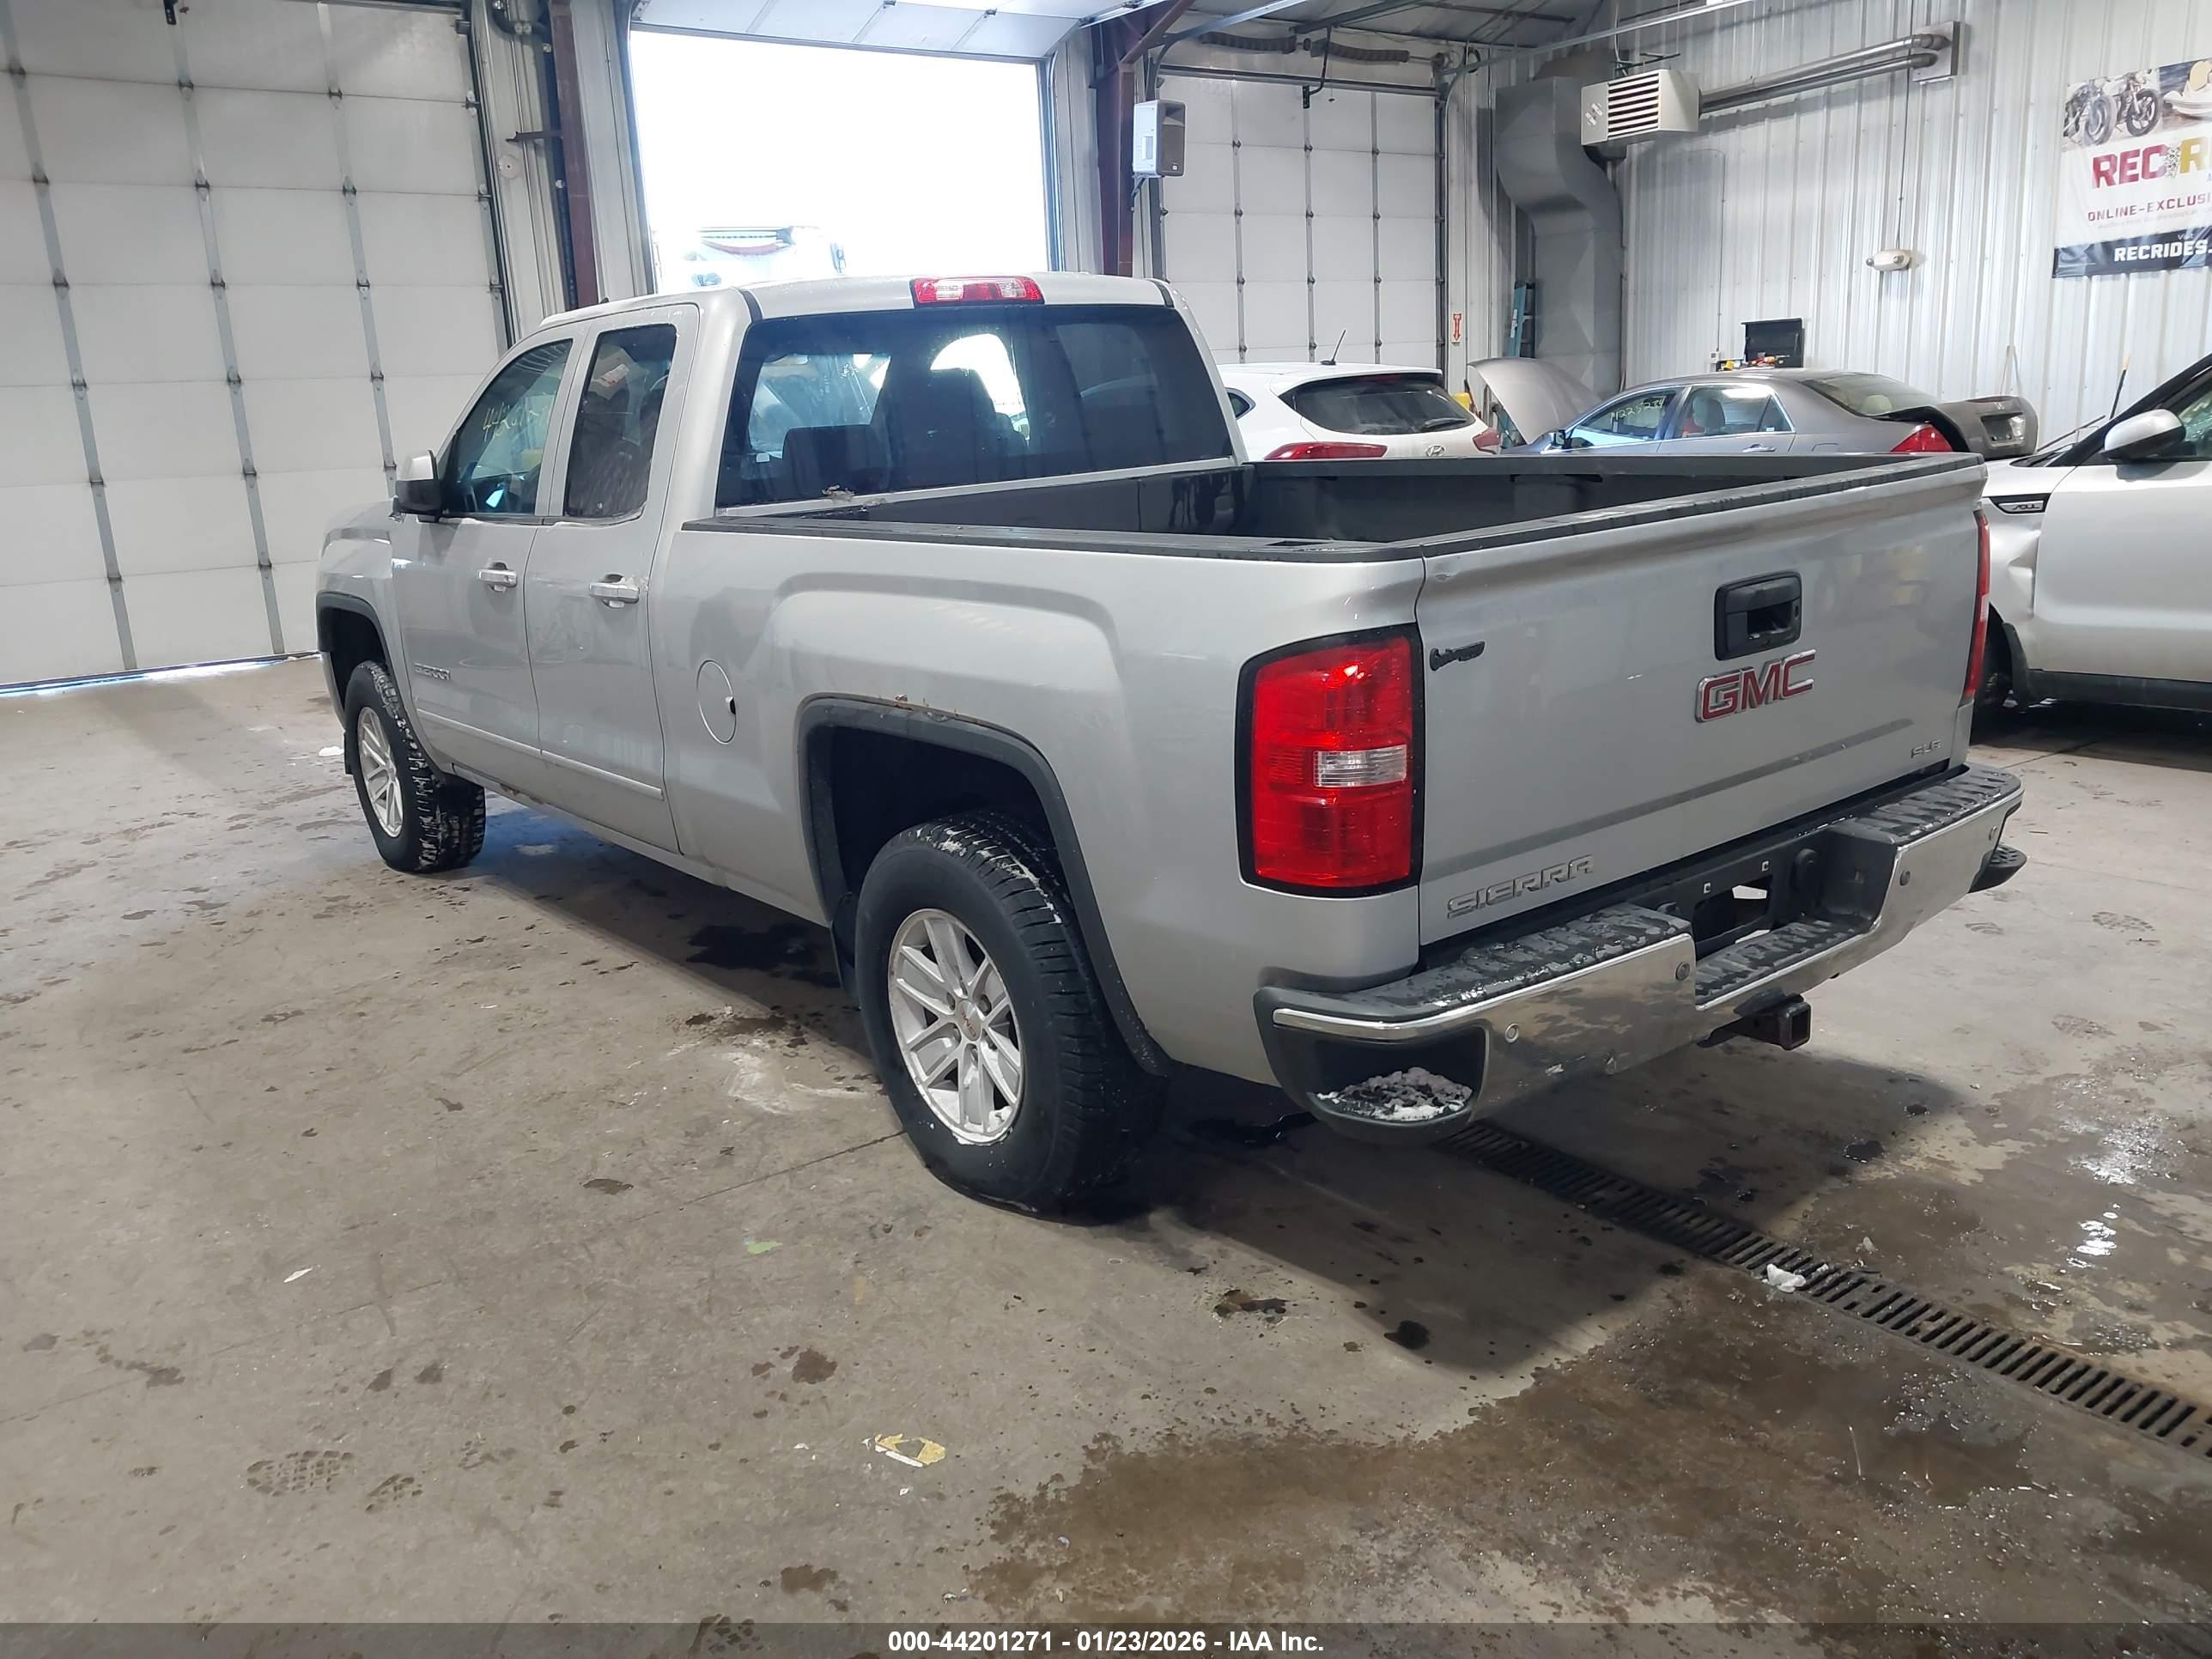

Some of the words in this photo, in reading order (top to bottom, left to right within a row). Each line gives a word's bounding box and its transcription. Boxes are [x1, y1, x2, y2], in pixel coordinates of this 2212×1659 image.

[2093, 144, 2167, 189] REC
[2179, 137, 2212, 173] R
[1695, 649, 1816, 723] GMC
[1447, 854, 1595, 920] SIERRA
